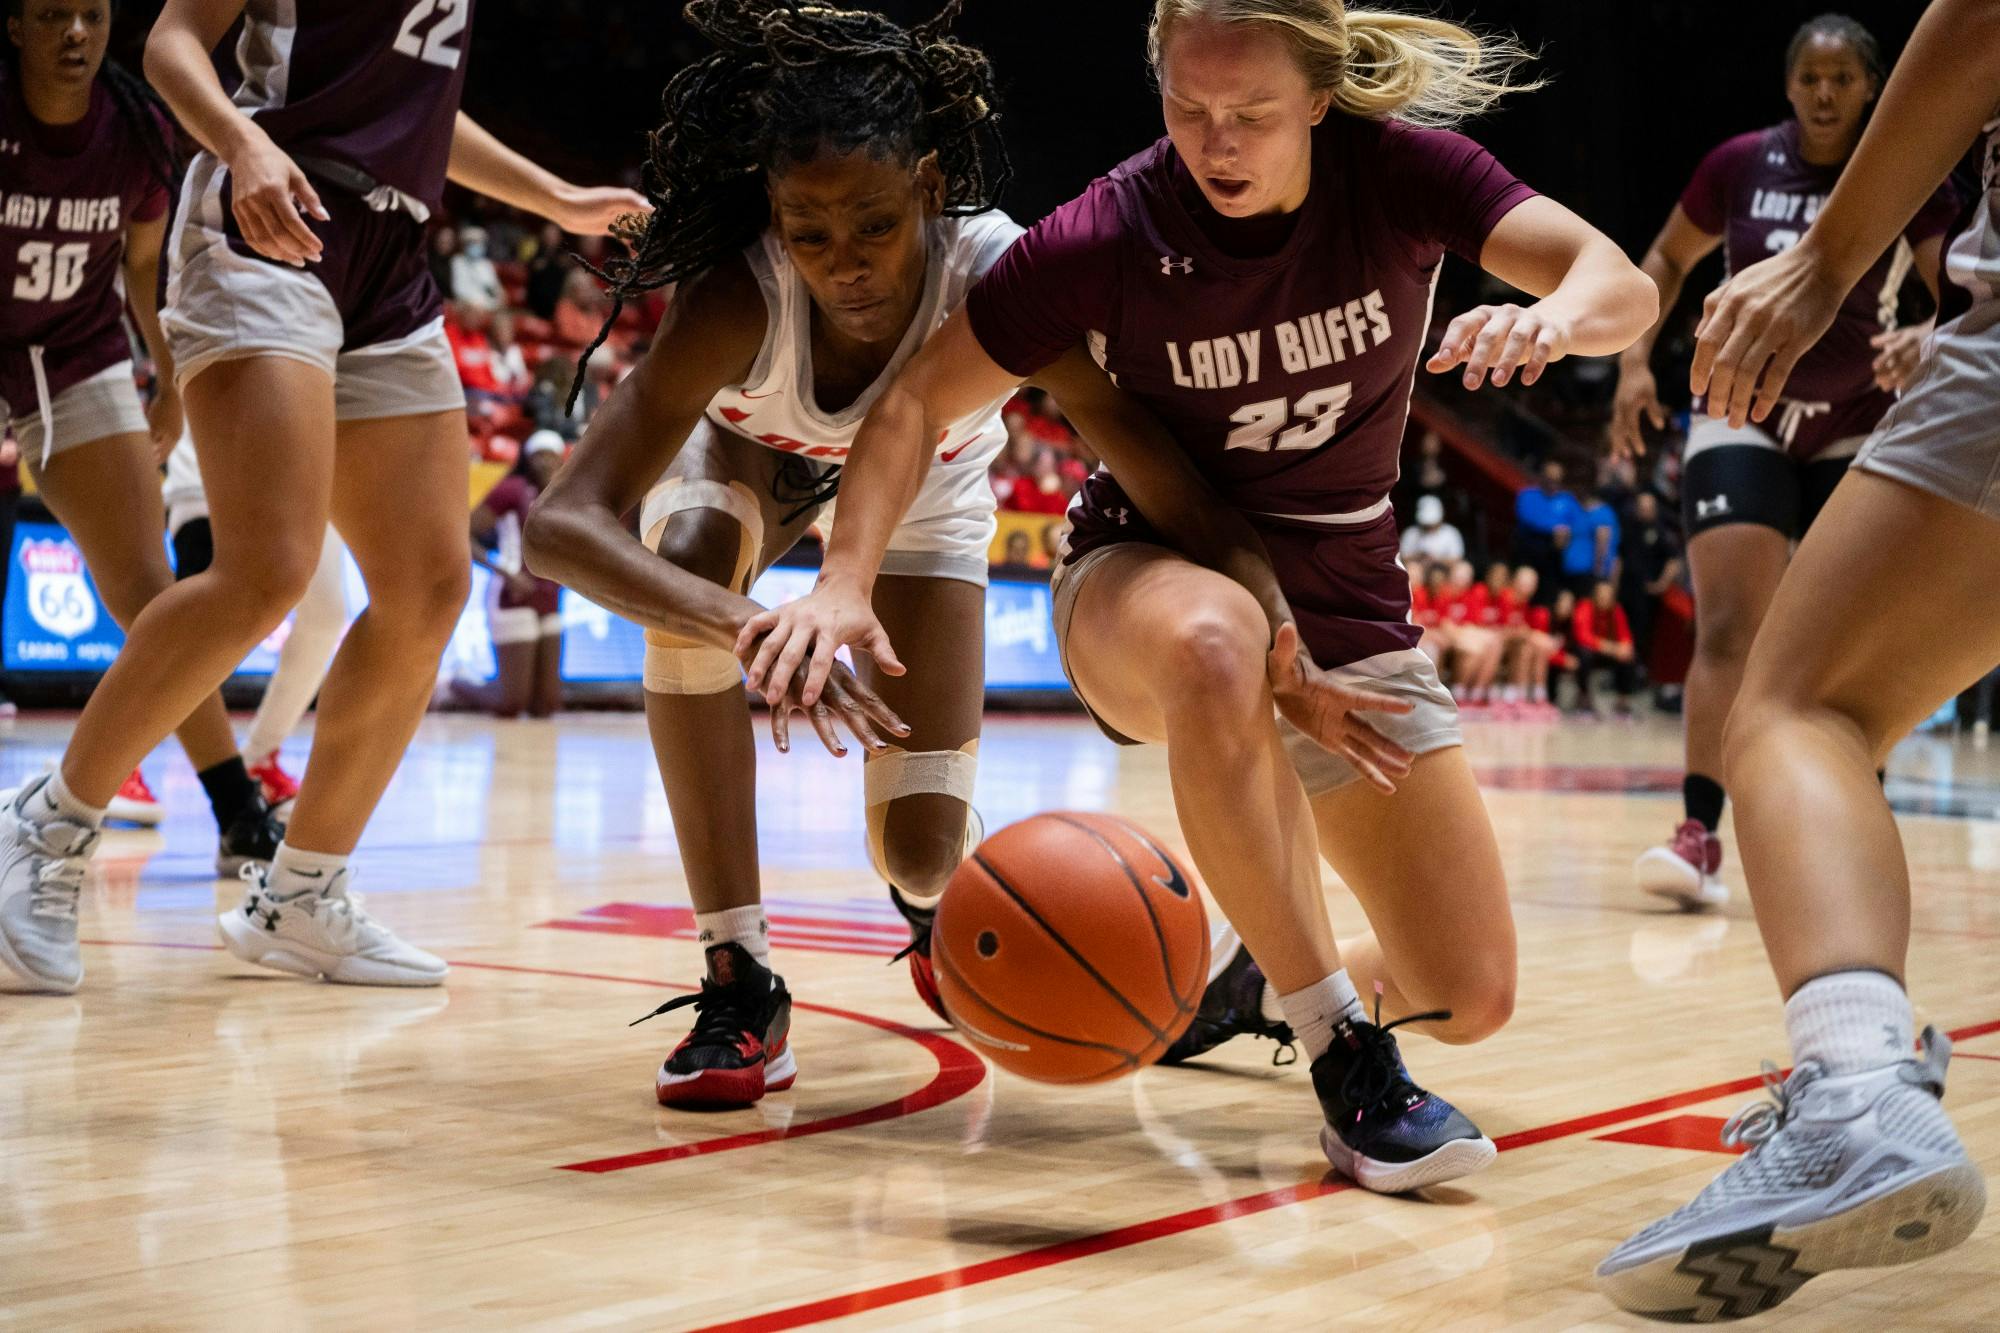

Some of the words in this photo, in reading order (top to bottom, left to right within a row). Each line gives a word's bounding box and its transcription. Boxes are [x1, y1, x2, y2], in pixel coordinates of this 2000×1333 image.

[392, 0, 468, 70] 22
[57, 195, 120, 232] BUFFS
[13, 241, 90, 302] 30
[1166, 329, 1261, 389] LADY
[1274, 288, 1392, 375] BUFFS
[1224, 382, 1353, 452] 23
[40, 584, 83, 619] 66
